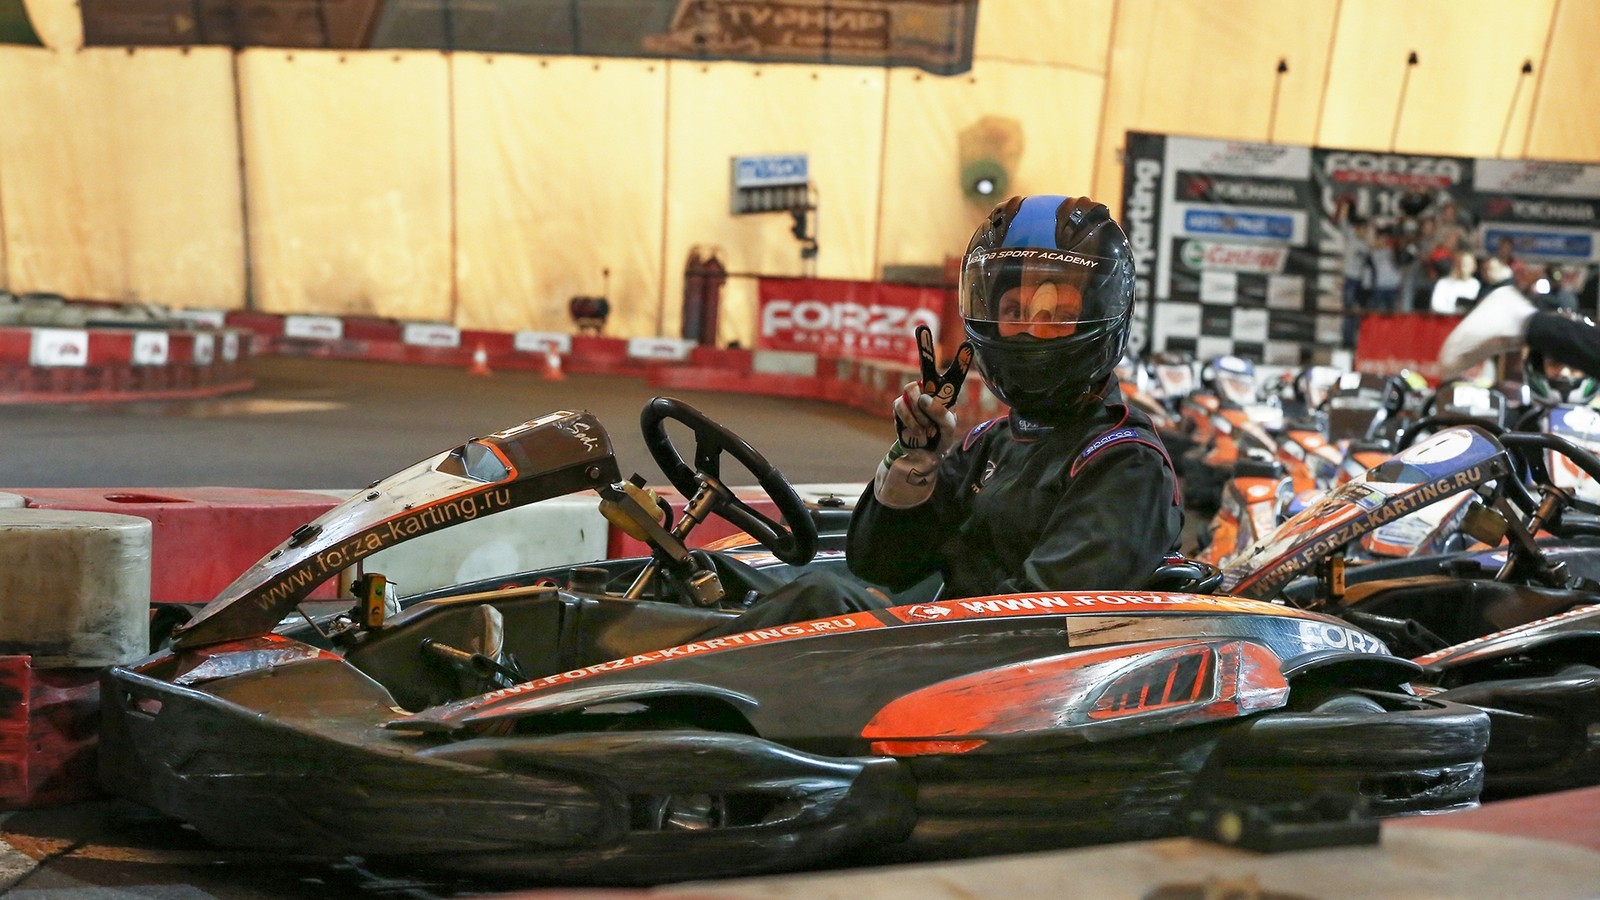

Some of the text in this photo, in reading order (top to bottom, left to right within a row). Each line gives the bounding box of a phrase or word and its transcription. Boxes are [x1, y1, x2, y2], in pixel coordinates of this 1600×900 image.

[996, 250, 1038, 259] SPORT
[1037, 252, 1099, 268] ACADEMY
[762, 299, 941, 346] FORZA
[256, 486, 512, 611] www.forza-karting.ru
[1252, 466, 1482, 597] WWW.FORZA-KARTING.RU
